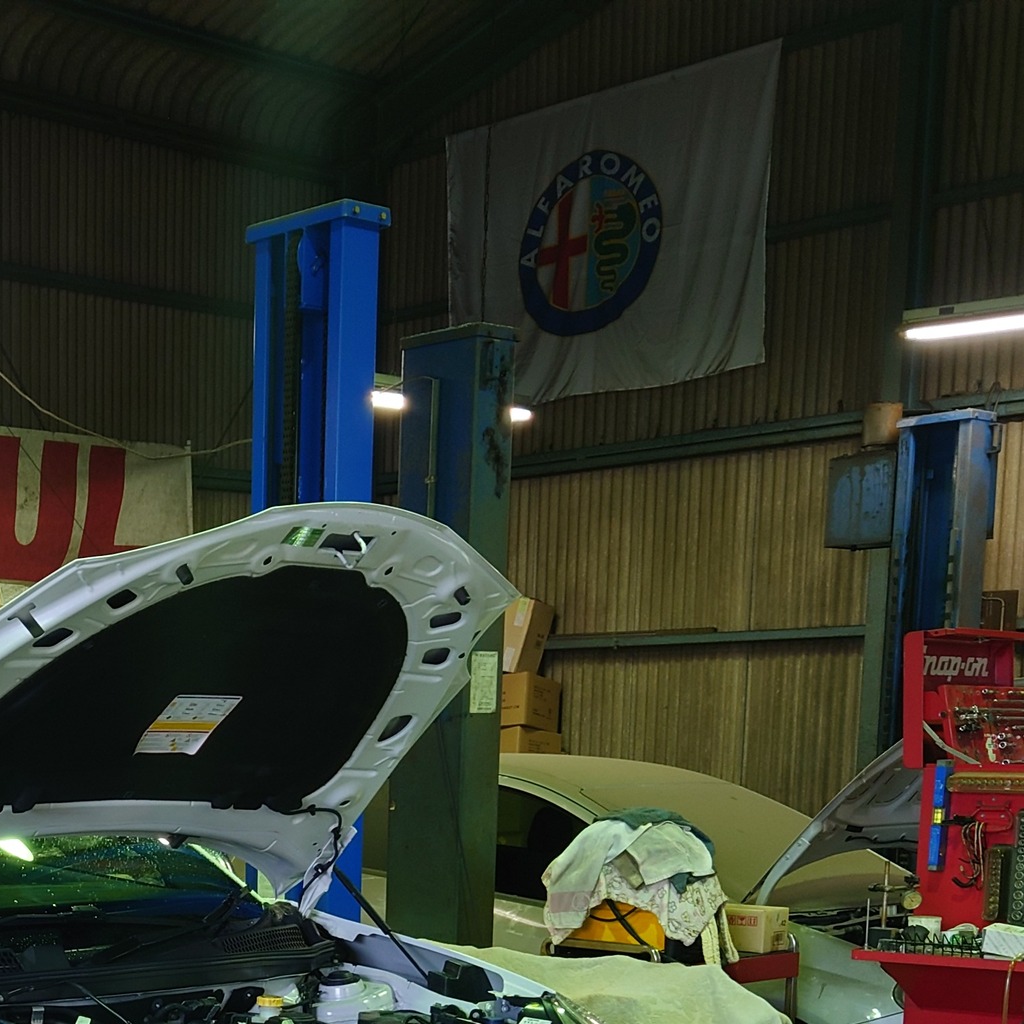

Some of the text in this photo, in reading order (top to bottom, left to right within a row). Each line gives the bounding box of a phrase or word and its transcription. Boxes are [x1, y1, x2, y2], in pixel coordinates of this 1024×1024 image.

[520, 152, 661, 268] ALFA ROMEO
[923, 645, 989, 682] nap-on
